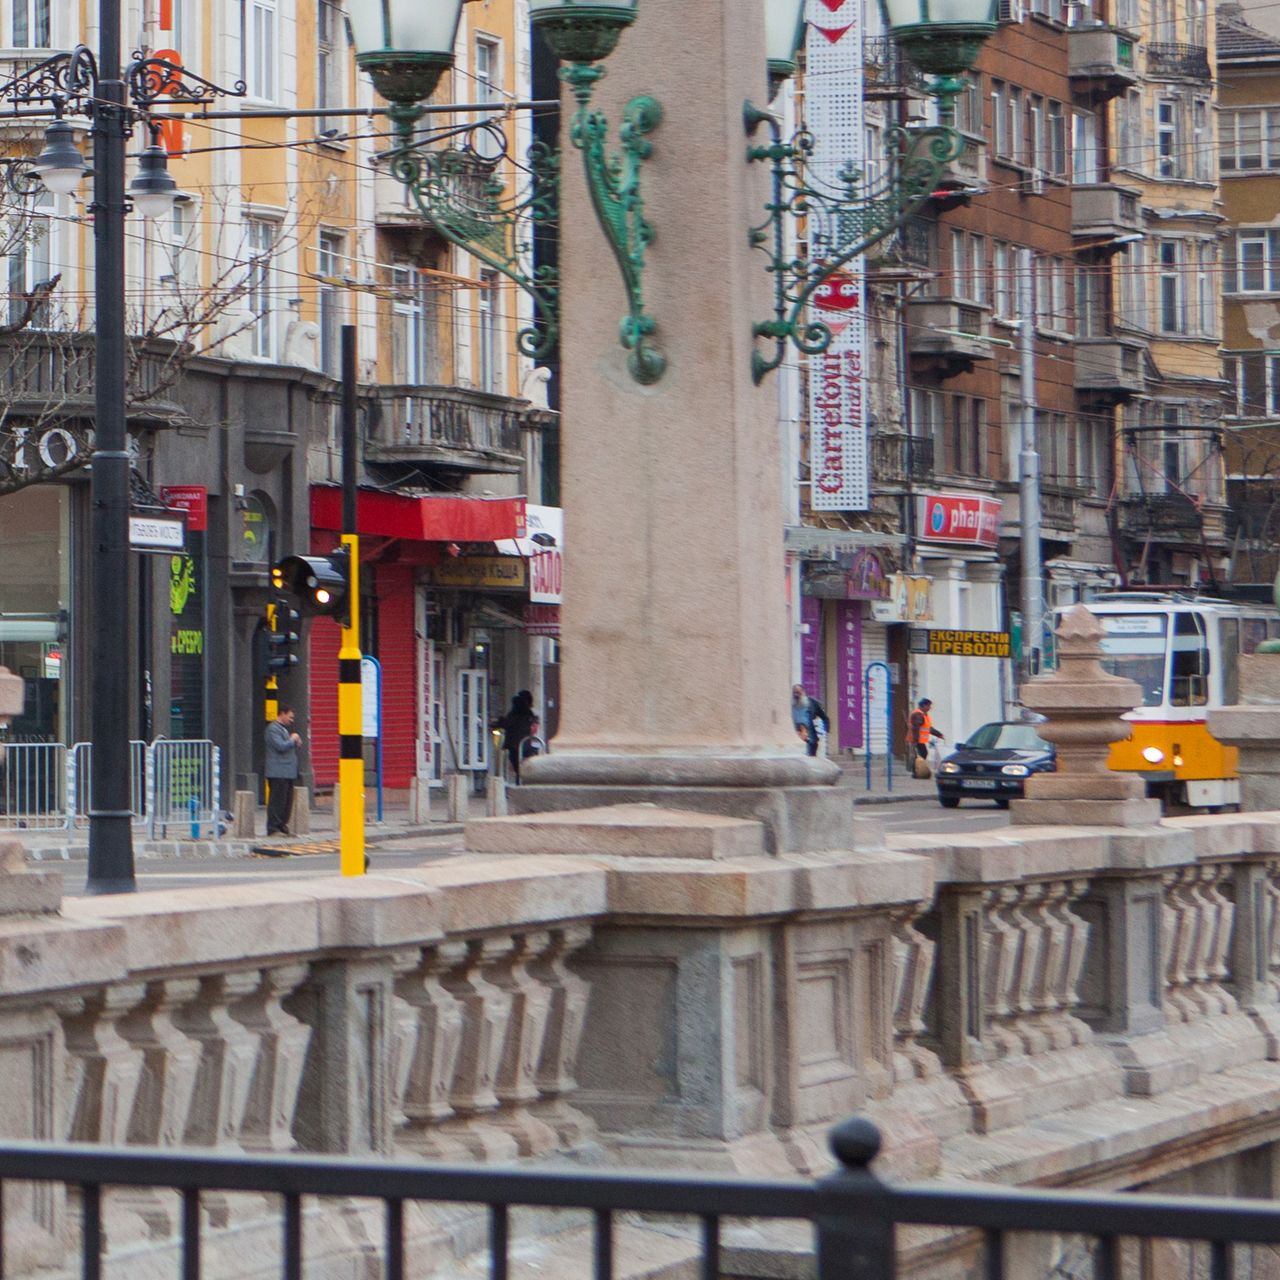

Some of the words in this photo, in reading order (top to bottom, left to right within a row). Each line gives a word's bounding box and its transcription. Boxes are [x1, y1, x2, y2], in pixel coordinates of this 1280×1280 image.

[816, 348, 844, 495] Carrefour
[845, 608, 857, 721] КОЗМЕТИКА
[929, 630, 1009, 644] ЕКСПРЕСНИ
[929, 641, 1009, 657] ПРЕВОДИ
